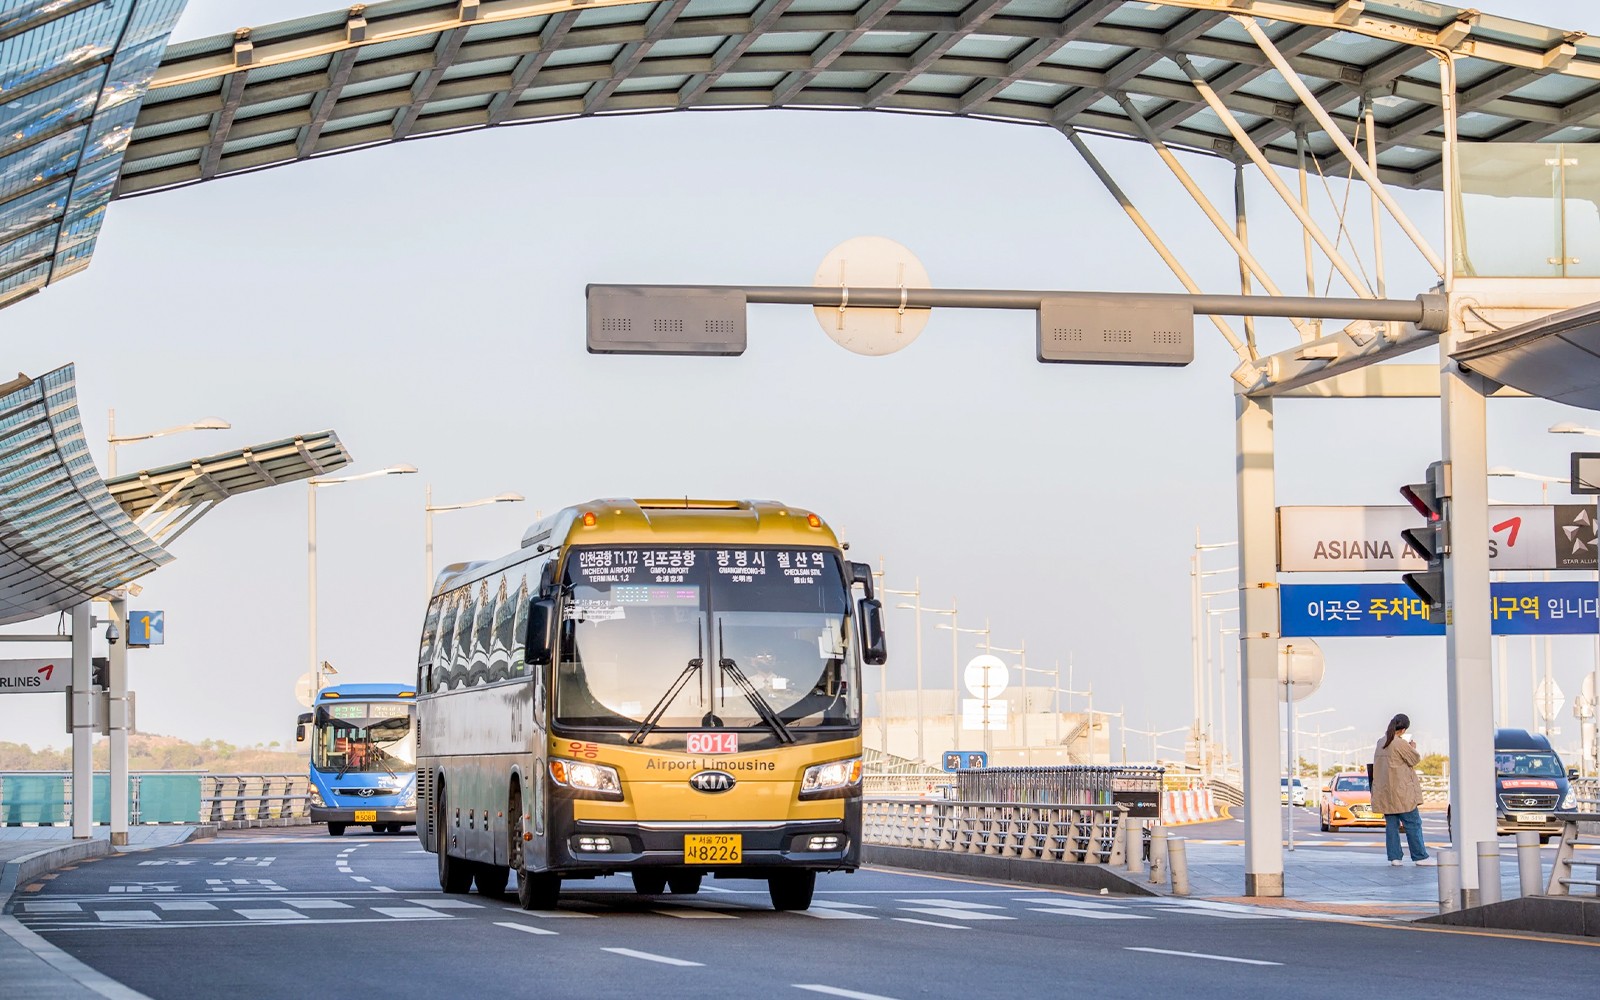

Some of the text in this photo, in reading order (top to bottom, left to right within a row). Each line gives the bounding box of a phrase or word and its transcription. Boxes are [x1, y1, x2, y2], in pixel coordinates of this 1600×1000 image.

[1313, 540, 1394, 559] ASIANA
[579, 550, 612, 568] 인천공항
[642, 550, 696, 567] 김포공항
[582, 567, 609, 575] INCHEON
[589, 575, 619, 583] TERMINAL
[1307, 600, 1363, 621] 이곳은
[1547, 598, 1599, 619] 입니다
[140, 615, 150, 640] 1
[568, 741, 599, 758] 우등
[687, 733, 738, 752] 6014
[646, 758, 776, 771] Airport Limousine
[697, 775, 730, 790] KIA
[699, 836, 728, 844] 서울 70
